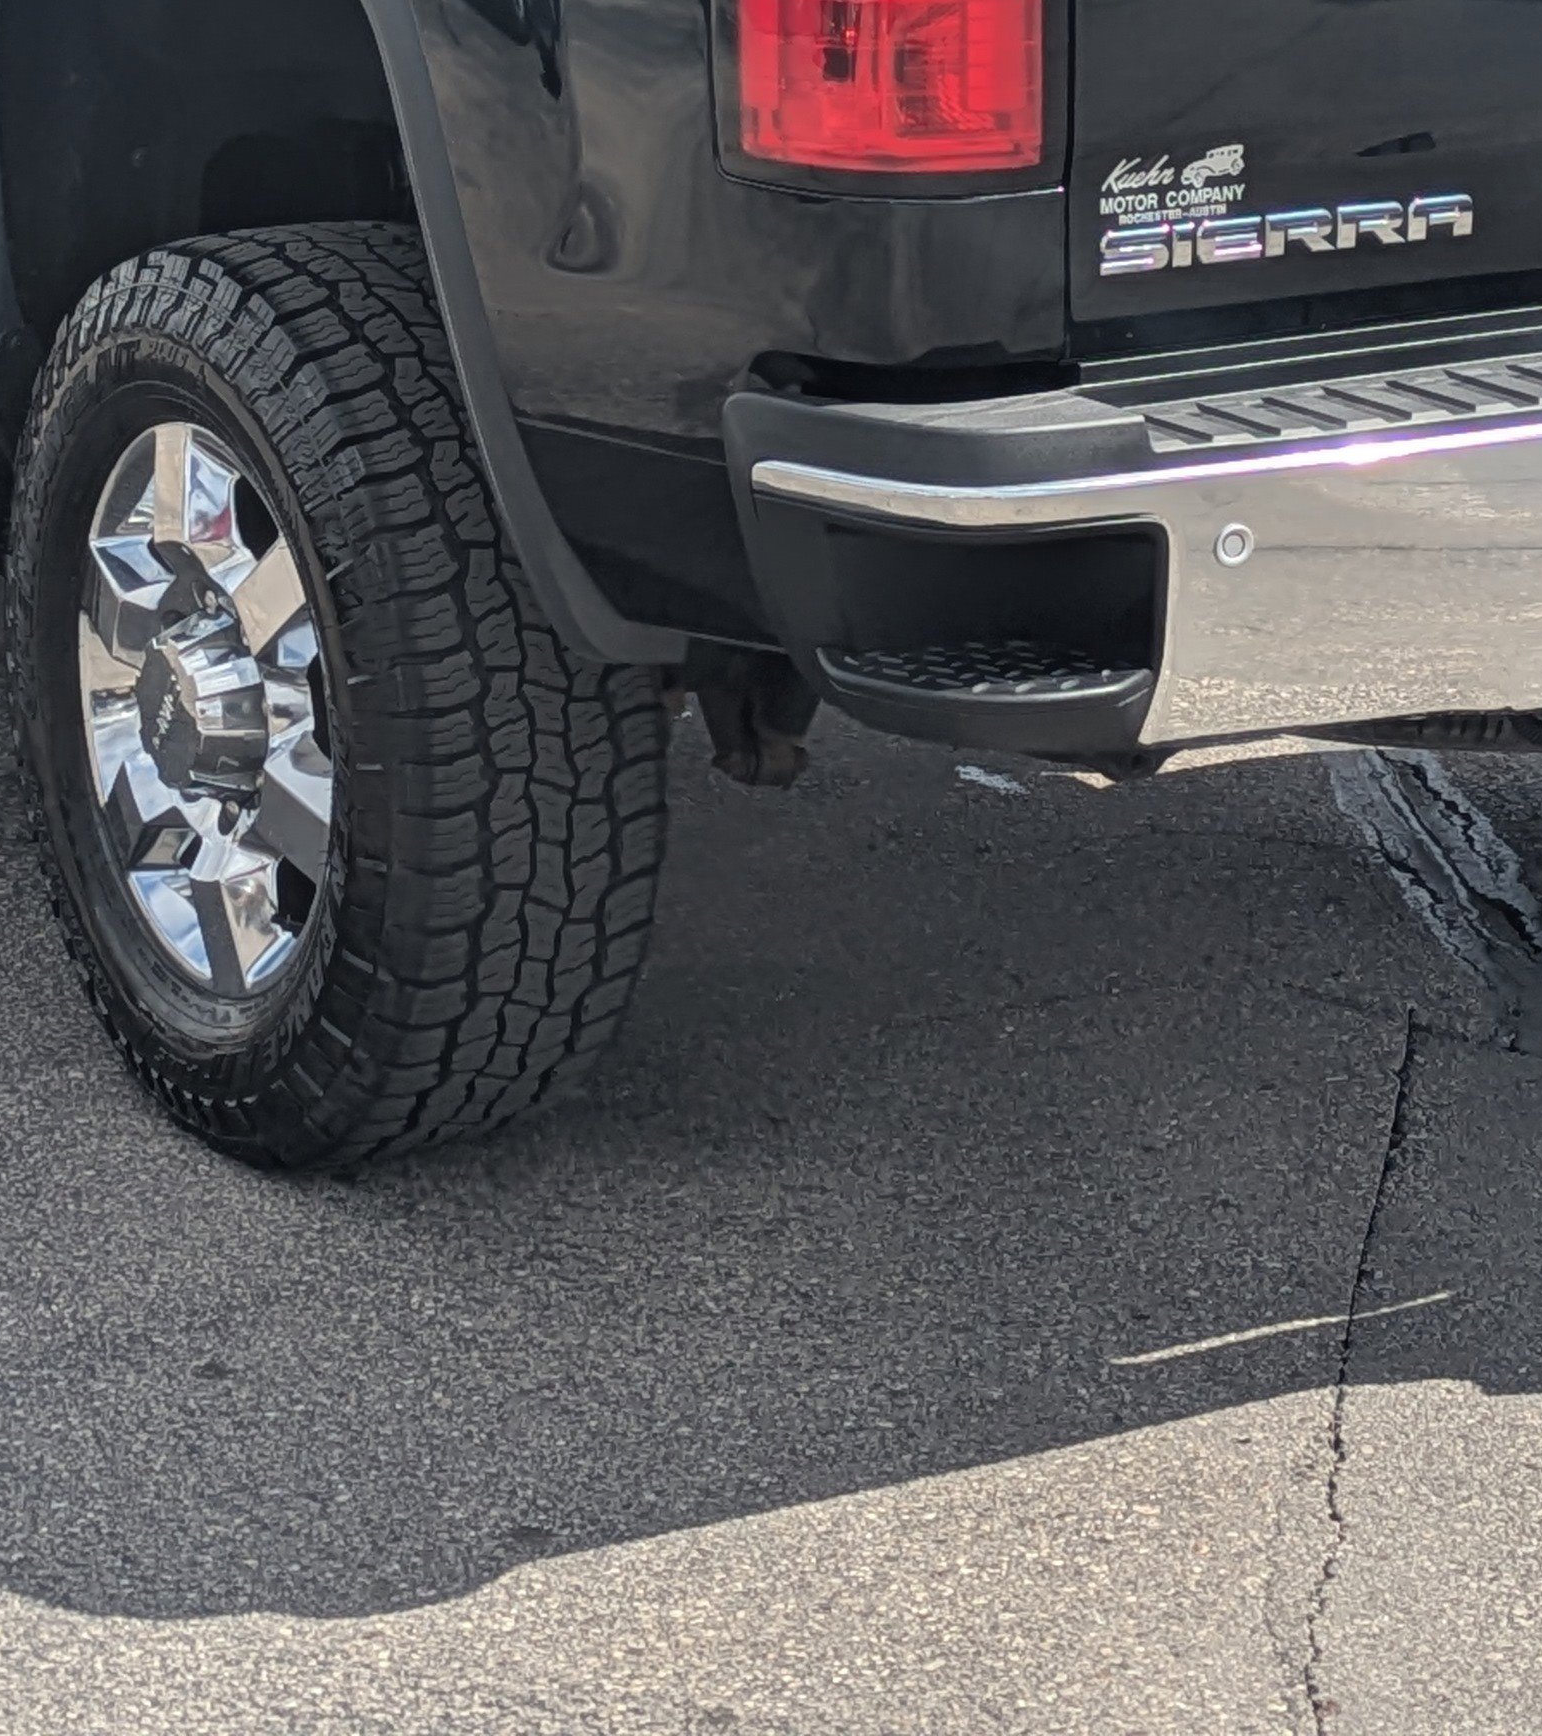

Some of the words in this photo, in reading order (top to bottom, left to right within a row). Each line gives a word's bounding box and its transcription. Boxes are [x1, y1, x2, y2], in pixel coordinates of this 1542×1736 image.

[1101, 154, 1175, 194] Kuehn
[1100, 193, 1158, 215] MOTOR
[1165, 184, 1246, 207] COMPANY
[1099, 193, 1473, 276] SIERRA
